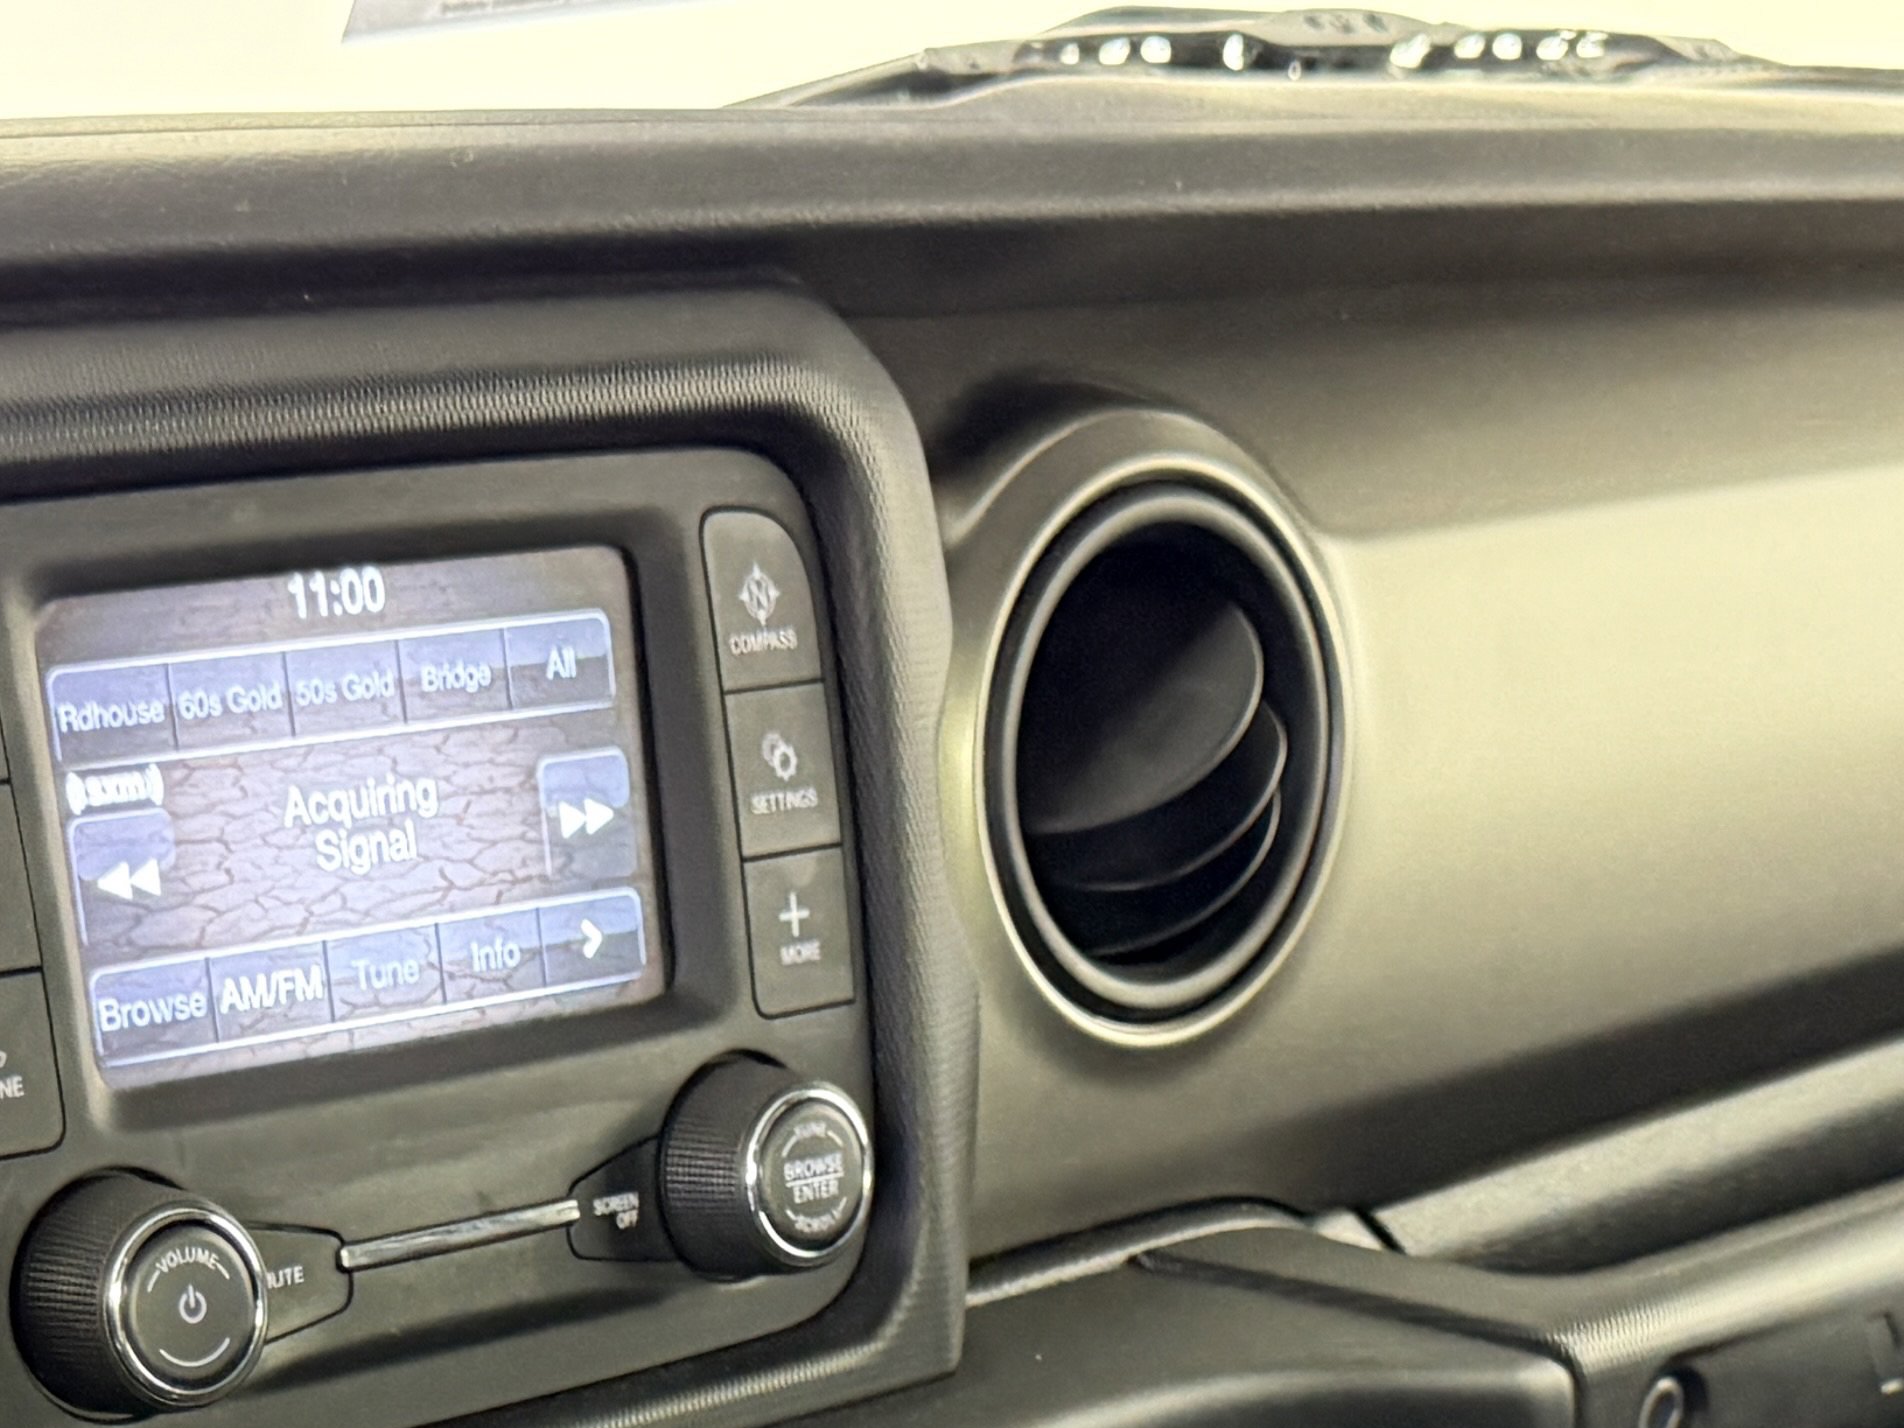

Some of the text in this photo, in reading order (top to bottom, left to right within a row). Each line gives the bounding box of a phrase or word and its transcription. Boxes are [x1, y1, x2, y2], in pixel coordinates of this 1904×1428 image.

[288, 566, 386, 619] 11:00
[421, 661, 492, 693] Bridge
[547, 645, 577, 680] All
[180, 683, 283, 720] 60s Gold
[296, 671, 397, 706] 50s Gold
[59, 700, 166, 733] Rdhouse
[284, 775, 439, 830] Acquiring
[316, 819, 418, 875] Signal
[472, 938, 521, 974] Info
[220, 966, 324, 1014] AM/FM
[353, 958, 420, 991] Tune
[100, 992, 207, 1032] Browse
[793, 1179, 840, 1204] ENTER
[156, 1246, 220, 1274] VOLUME
